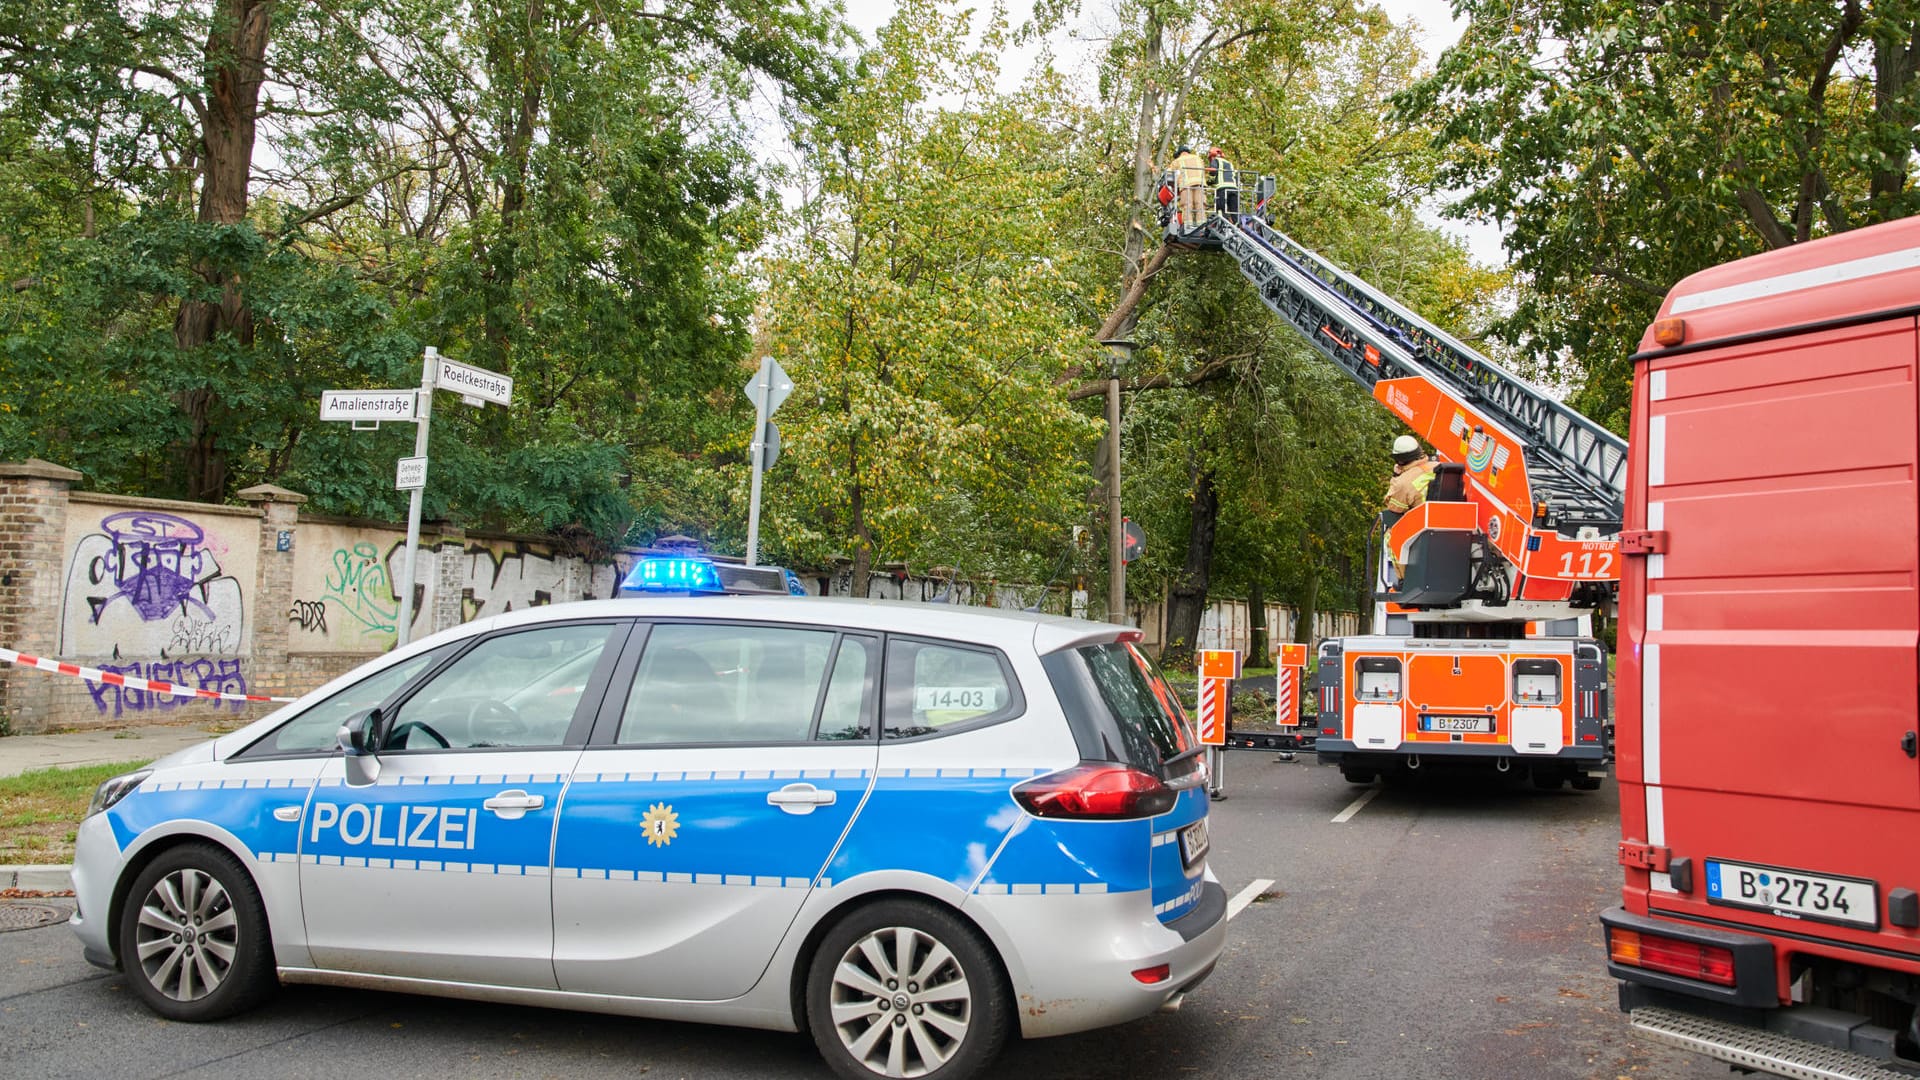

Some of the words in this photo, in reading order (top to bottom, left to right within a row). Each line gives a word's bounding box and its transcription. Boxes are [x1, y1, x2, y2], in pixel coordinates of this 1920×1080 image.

[443, 365, 506, 396] Roelckestraße
[329, 397, 409, 413] Amalienstraße
[1581, 541, 1617, 551] NOTRUF
[1557, 551, 1613, 578] 112
[929, 690, 983, 707] 14-03
[1439, 718, 1446, 729] B
[1453, 719, 1479, 730] 2307
[311, 802, 477, 850] POLIZEI
[1740, 870, 1757, 899] B
[1775, 876, 1850, 914] 2734
